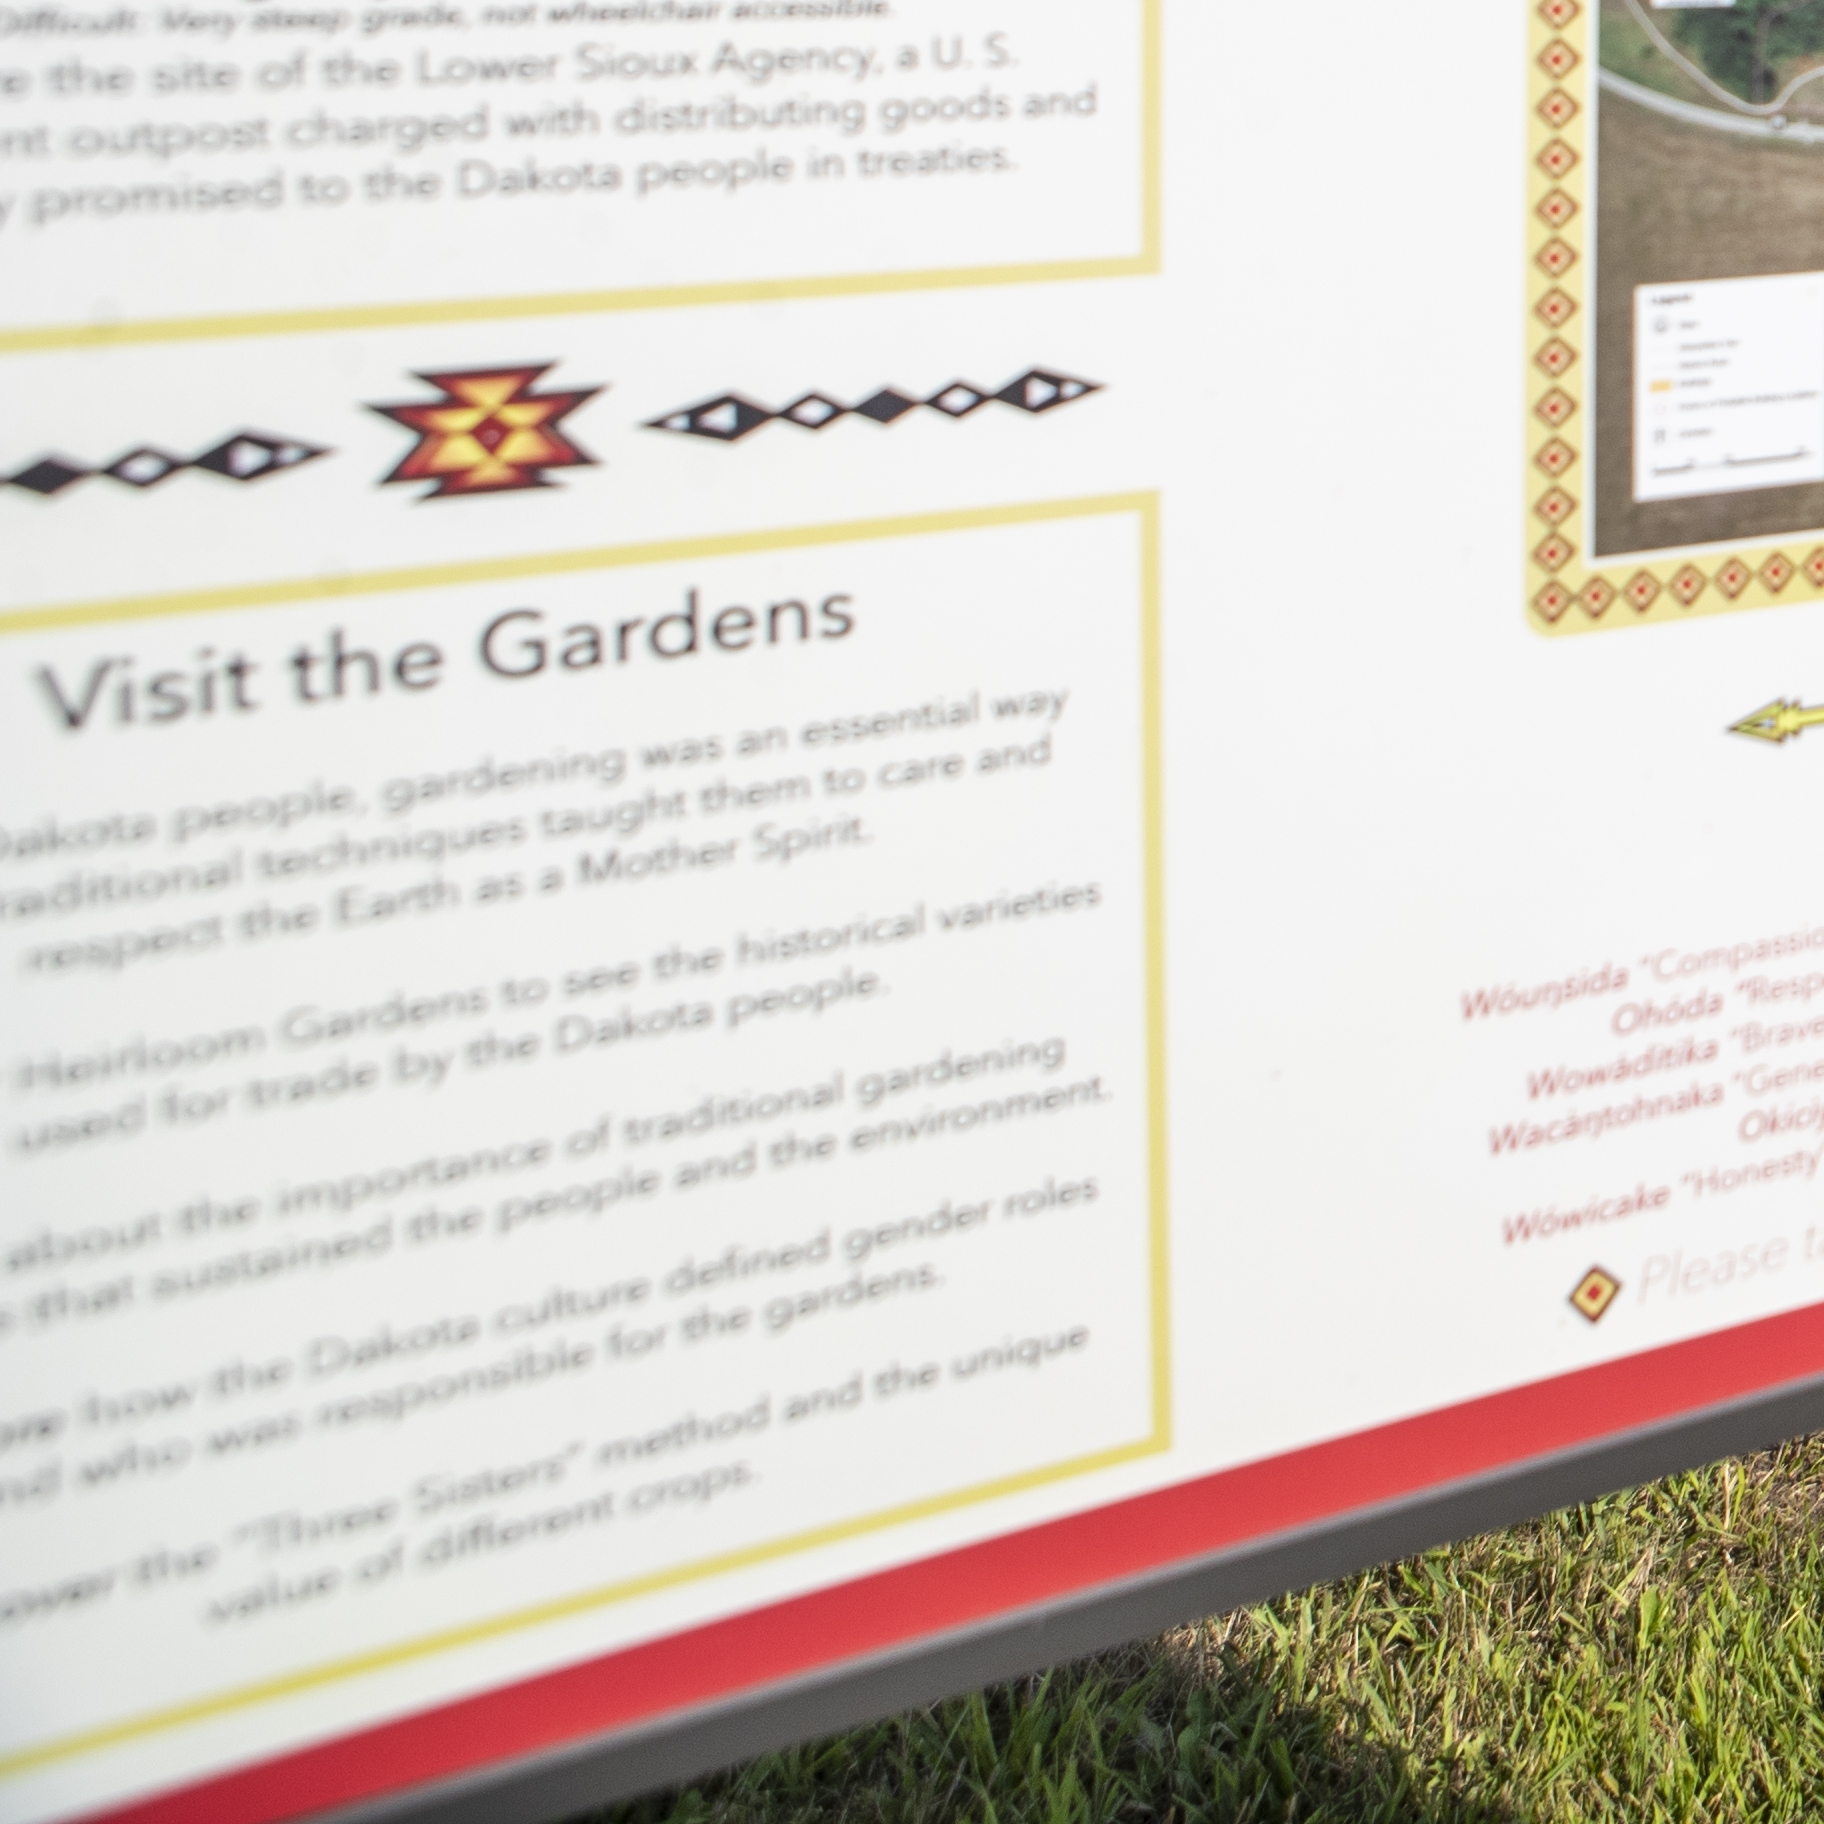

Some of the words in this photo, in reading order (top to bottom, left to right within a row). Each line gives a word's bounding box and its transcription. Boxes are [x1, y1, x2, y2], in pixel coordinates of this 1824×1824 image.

[42, 58, 136, 98] the
[148, 60, 242, 95] site
[253, 49, 308, 93] of
[318, 51, 402, 88] the
[413, 50, 559, 87] Lower
[574, 42, 699, 82] Sioux
[64, 117, 271, 163] outpost
[283, 103, 492, 155] charged
[502, 100, 601, 139] with
[612, 94, 868, 137] distributing
[877, 86, 1012, 136] goods
[1022, 82, 1099, 119] and
[24, 169, 287, 228] promised
[295, 173, 351, 207] to
[361, 165, 443, 203] the
[454, 158, 624, 199] Dakota
[634, 147, 795, 198] people
[36, 647, 259, 735] Visit
[288, 627, 443, 706] the
[476, 586, 854, 681] Gardens
[379, 748, 629, 818] gardening
[638, 736, 724, 769] was
[799, 691, 982, 748] essential
[990, 691, 1068, 722] way
[537, 788, 688, 839] taught
[697, 776, 812, 815] them
[876, 754, 965, 790] care
[975, 731, 1054, 775] and
[575, 839, 738, 886] Mother
[734, 902, 927, 966] historical
[936, 883, 1102, 932] varieties
[551, 1001, 715, 1055] Dakota
[621, 1071, 845, 1147] traditional
[854, 1037, 1068, 1111] gardening
[662, 1227, 833, 1297] defined
[841, 1200, 991, 1283] gender
[1002, 1177, 1099, 1219] roles
[950, 1325, 1090, 1381] unique
